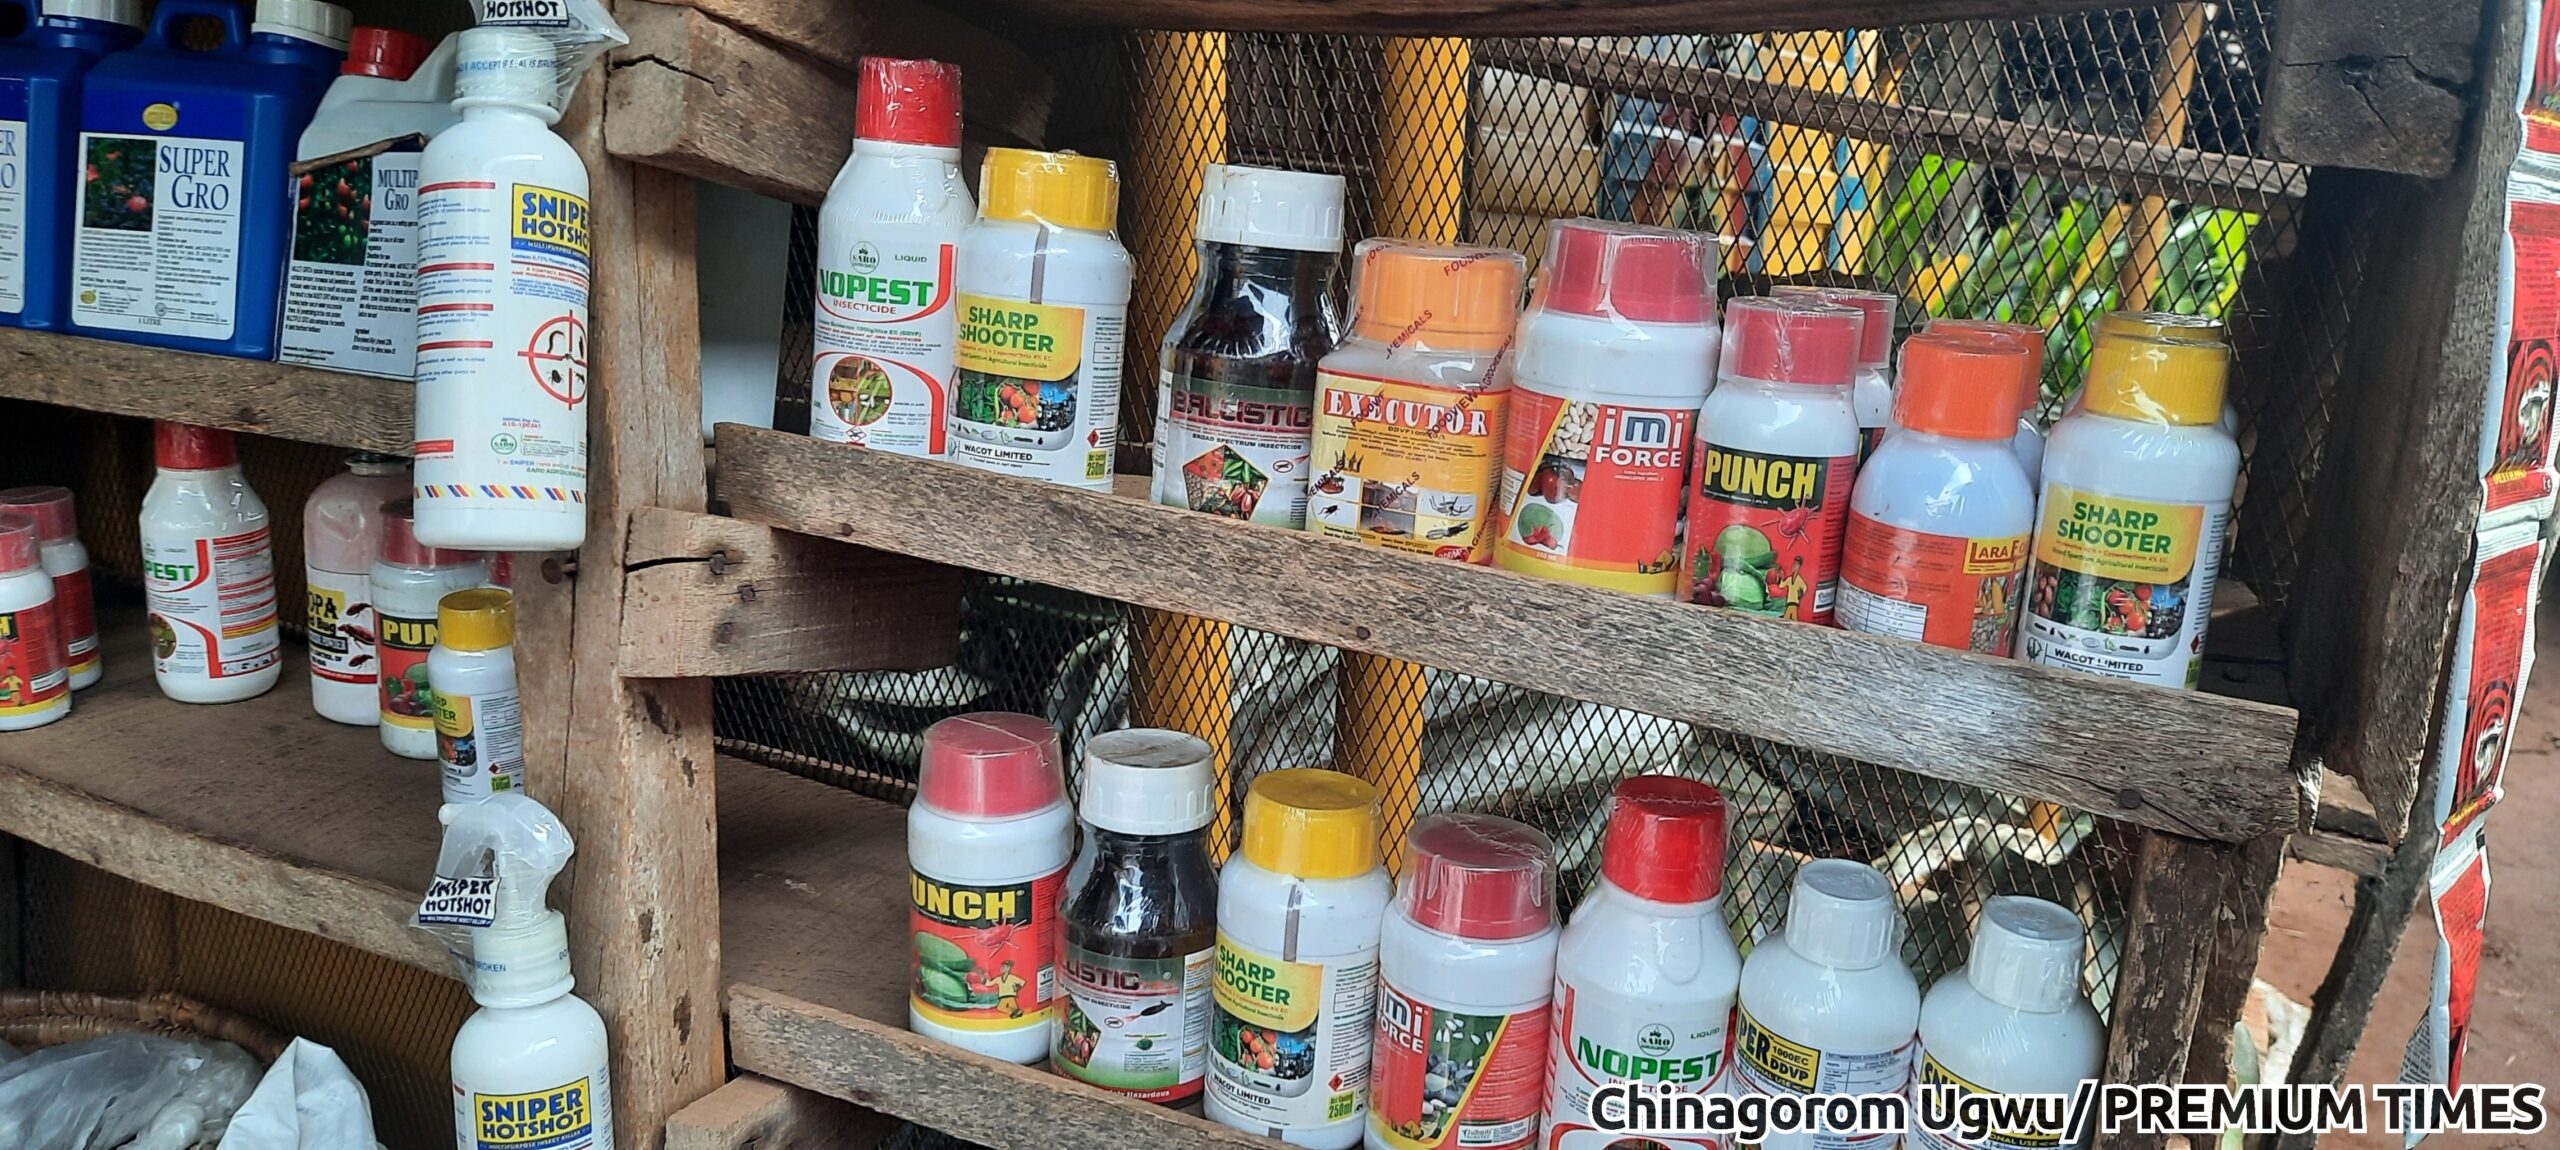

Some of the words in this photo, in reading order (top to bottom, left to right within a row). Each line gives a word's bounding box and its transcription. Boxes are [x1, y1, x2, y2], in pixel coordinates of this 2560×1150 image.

[486, 0, 559, 19] HOTSHOT
[470, 60, 500, 72] ACCEPT
[159, 144, 231, 177] SUPER
[171, 175, 229, 211] GRO
[384, 188, 410, 211] GRO
[894, 254, 928, 263] LIQUID
[819, 268, 934, 307] NOPEST
[832, 298, 897, 315] INSECTICIDE
[968, 305, 1039, 331] SHARP
[959, 324, 1054, 353] SHOOTER
[1327, 389, 1489, 437] EXECUTOR
[964, 443, 993, 456] WACOT
[994, 449, 1034, 462] LIMITED
[1216, 436, 1256, 448] SPECTRUM
[1594, 446, 1682, 468] FORCE
[1704, 449, 1817, 500] PUNCH
[2073, 501, 2159, 531] SHARP
[2057, 518, 2172, 554] SHOOTER
[2054, 648, 2095, 665] WACOT
[425, 897, 491, 916] HOTSHOT
[909, 873, 1016, 921] UNCH
[1219, 944, 1276, 982] SHARP
[1378, 1014, 1425, 1055] ORCE
[1640, 1036, 1671, 1046] SARO
[1690, 1026, 1721, 1040] LIQUID
[1577, 1035, 1723, 1084] NOPEST
[1772, 1045, 1810, 1066] 1000EC
[1770, 1057, 1809, 1082] DDVP
[1214, 1073, 1236, 1094] WACOT
[1237, 1088, 1271, 1106] LIMITED
[481, 1087, 582, 1122] SNIPER
[482, 1109, 584, 1140] HOTSHOT
